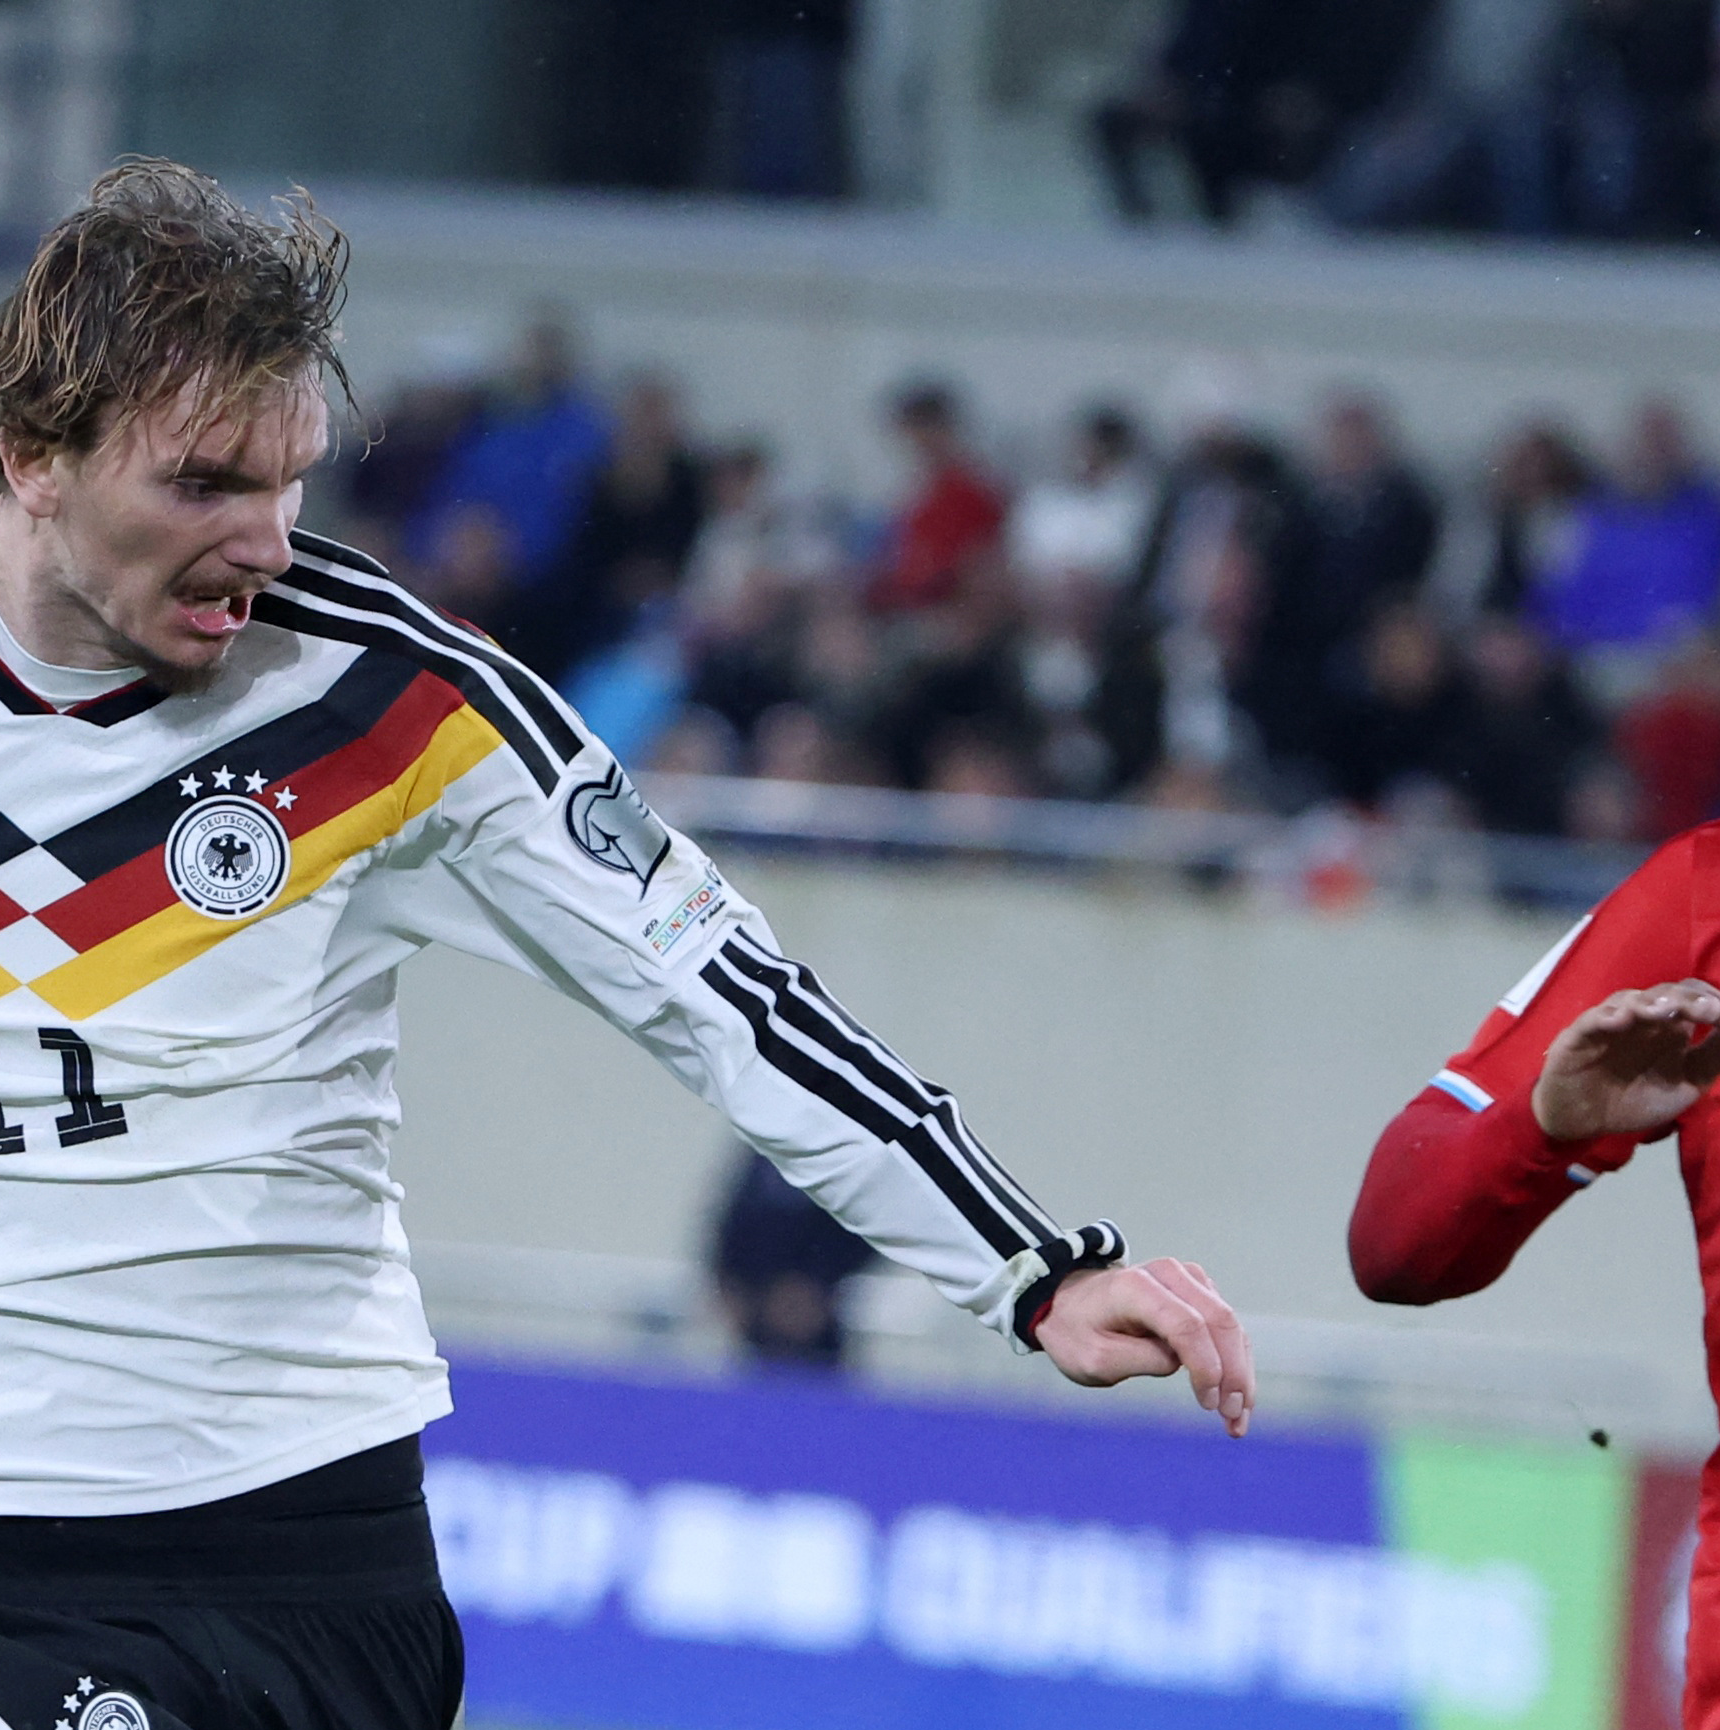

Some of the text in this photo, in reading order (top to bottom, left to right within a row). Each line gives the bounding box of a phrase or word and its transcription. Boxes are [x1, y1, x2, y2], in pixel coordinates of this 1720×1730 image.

[199, 814, 264, 841] DEUTSCHER
[186, 864, 266, 900] FUSSBALL-BUND
[651, 882, 718, 953] FOUNDATION
